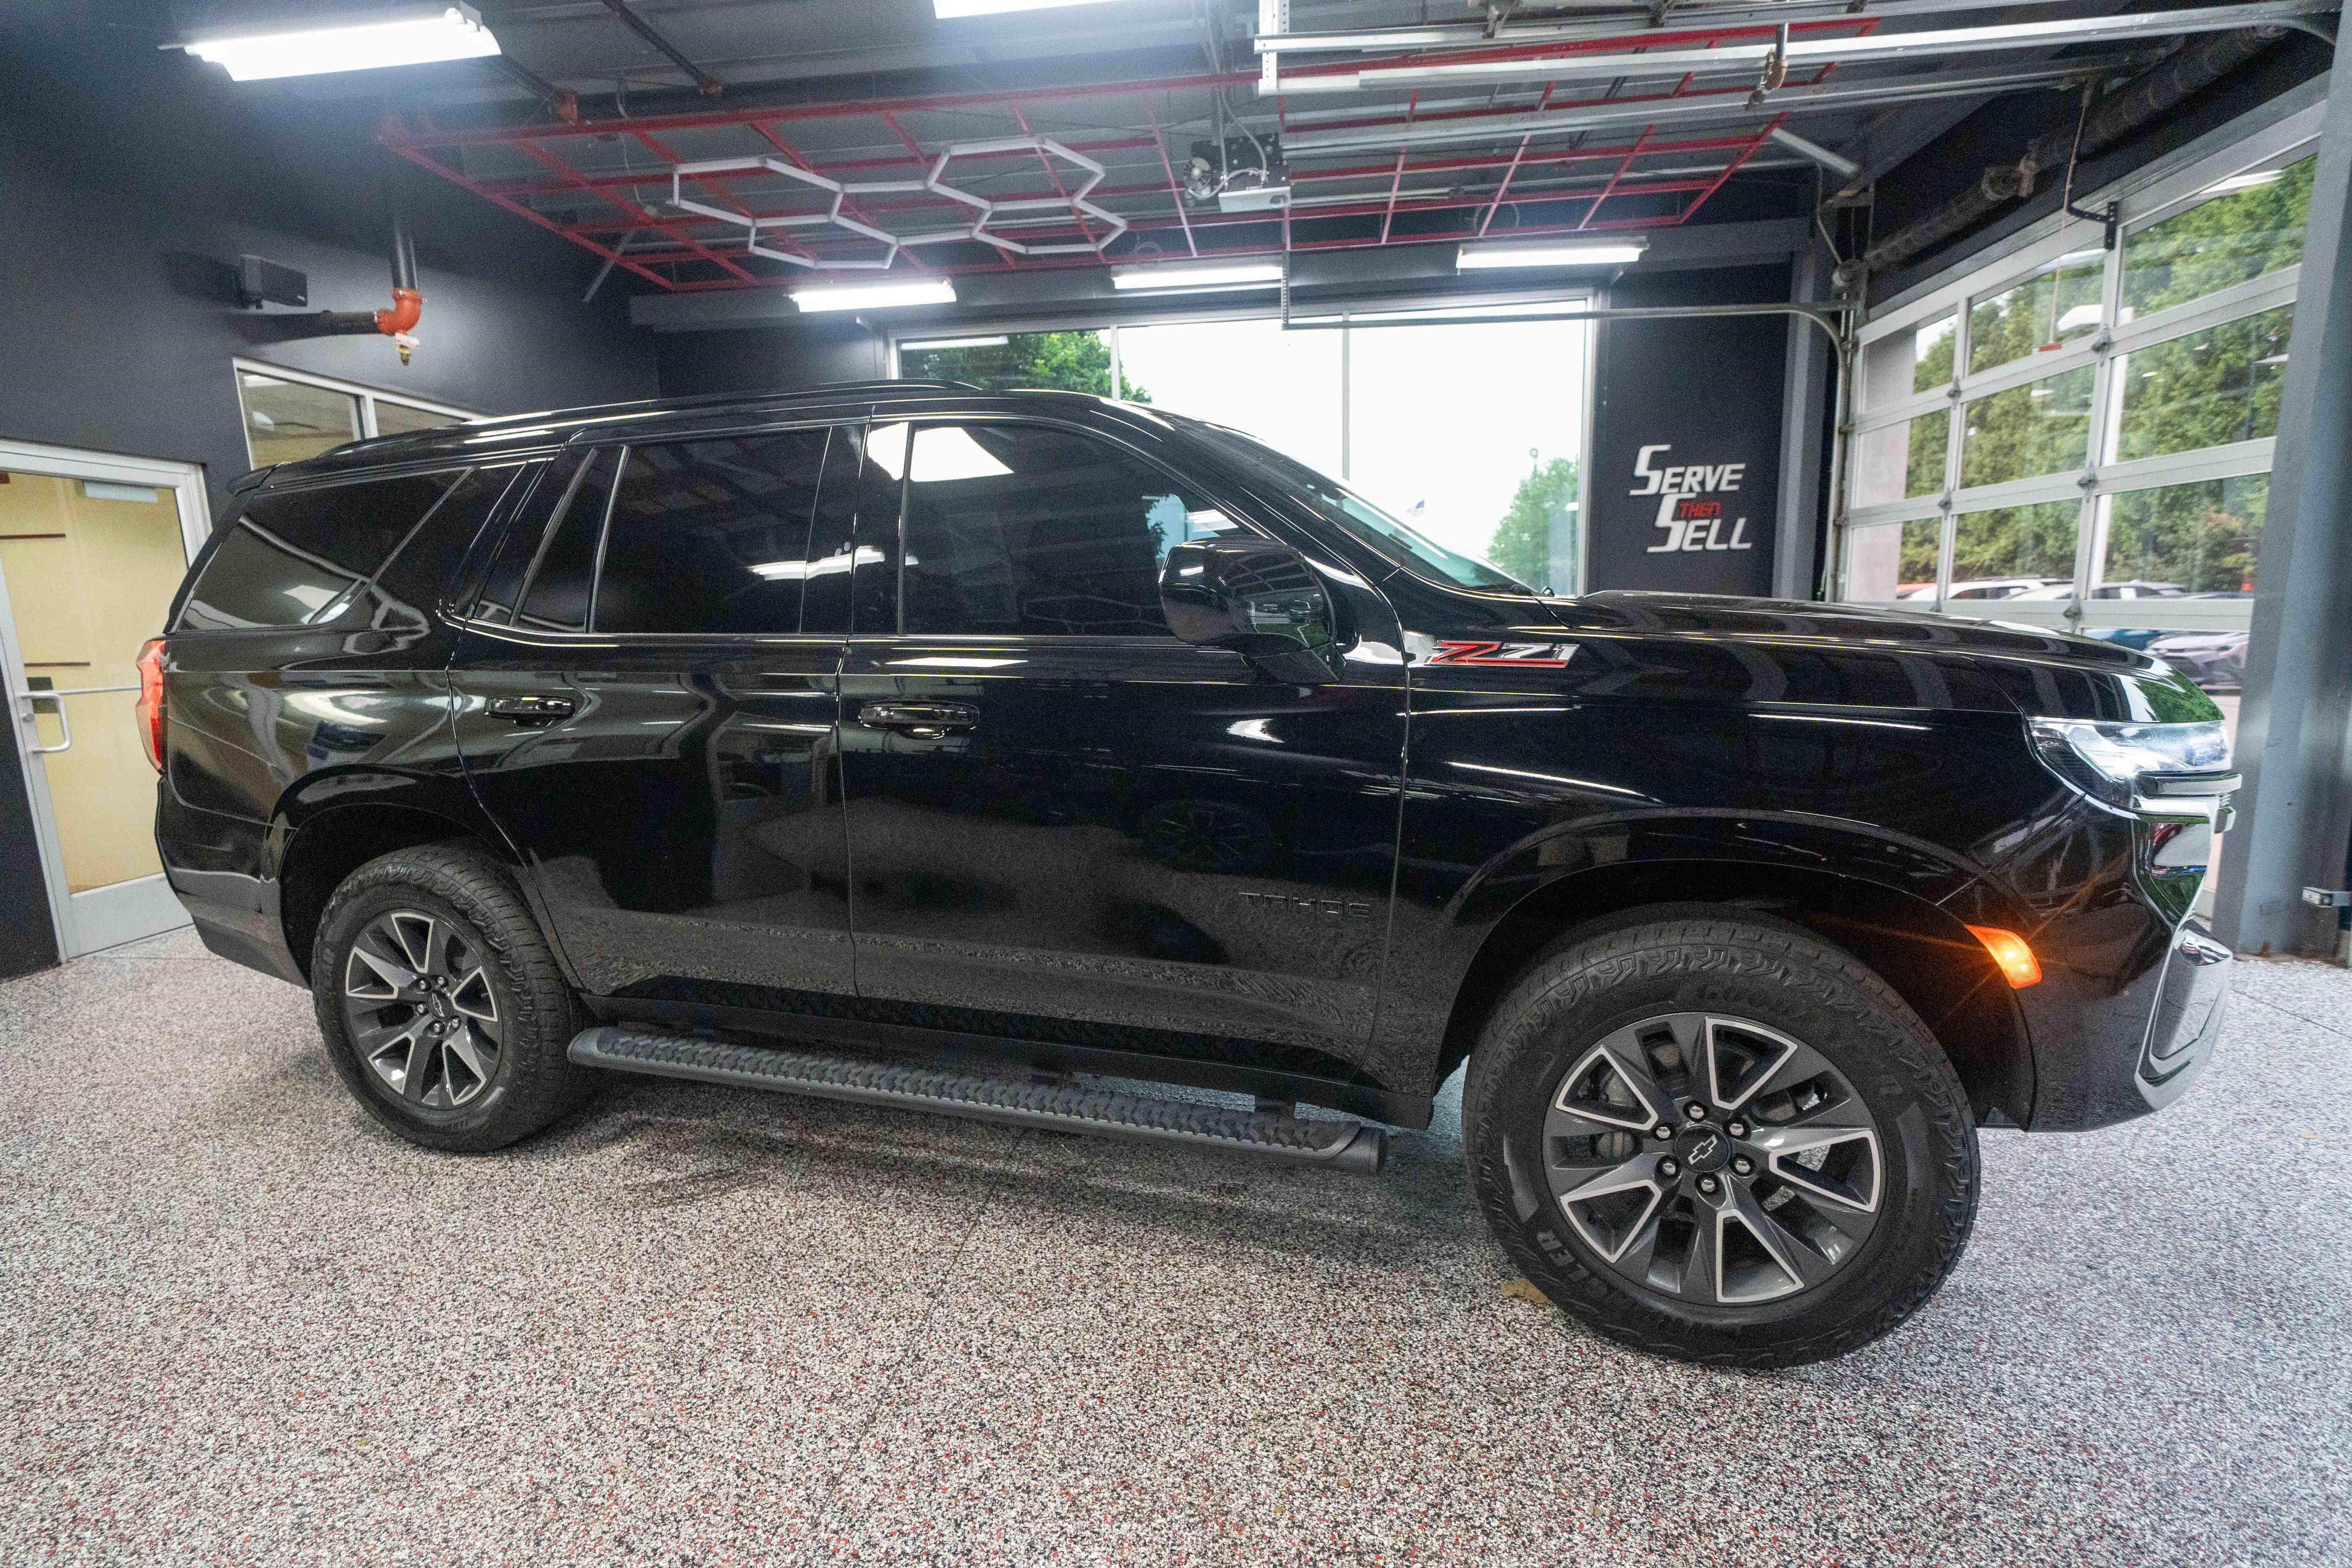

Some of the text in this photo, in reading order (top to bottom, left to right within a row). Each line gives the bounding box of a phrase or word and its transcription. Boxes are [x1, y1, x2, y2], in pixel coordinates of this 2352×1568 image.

[1629, 444, 1746, 495] SERVE
[1647, 493, 1752, 552] SELL
[1424, 640, 1579, 668] Z71
[1238, 892, 1371, 918] TAHOE
